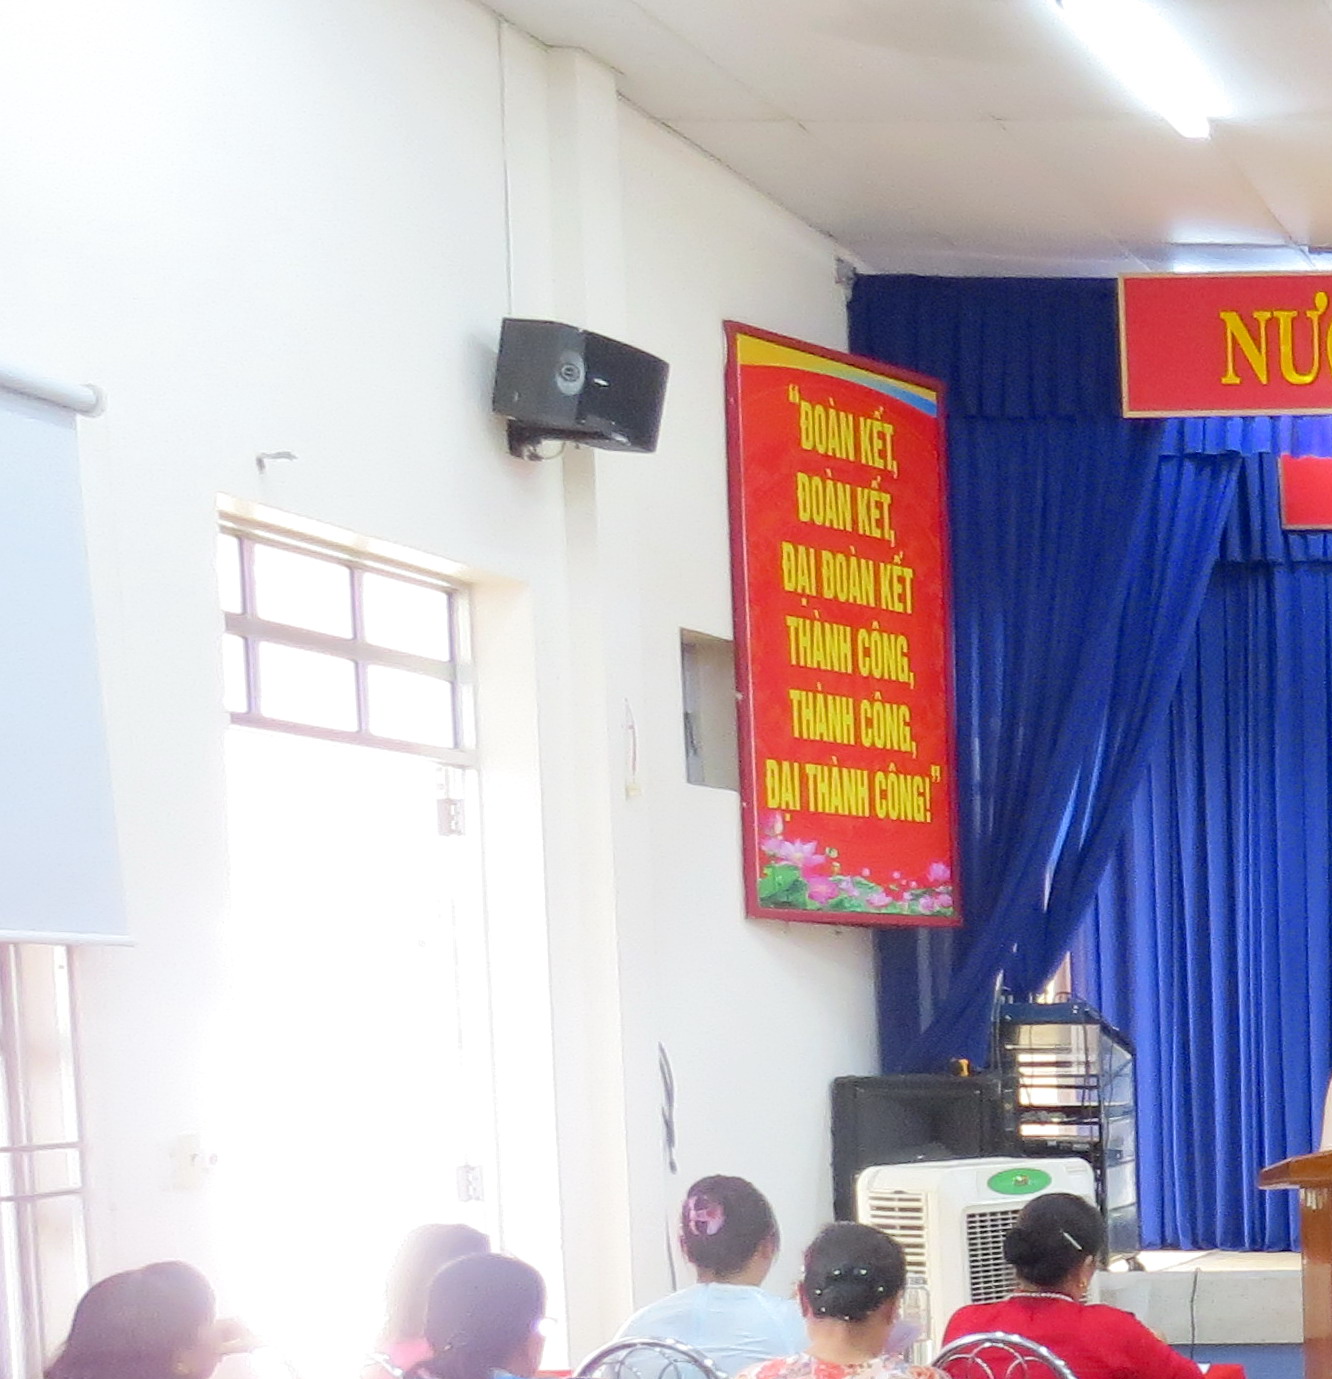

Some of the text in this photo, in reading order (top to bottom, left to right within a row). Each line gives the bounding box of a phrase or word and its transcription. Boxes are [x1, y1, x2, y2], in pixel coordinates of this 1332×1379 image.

[860, 406, 899, 479] KẾT,
[796, 468, 896, 547] ĐOÀN KẾT,
[781, 541, 915, 615] ĐẠI ĐOÀN KẾT
[786, 610, 915, 689] THÀNH CÔNG,
[788, 683, 918, 759] THÀNH CÔNG,
[766, 760, 802, 823] ĐẠI
[805, 759, 871, 818] THÀNH
